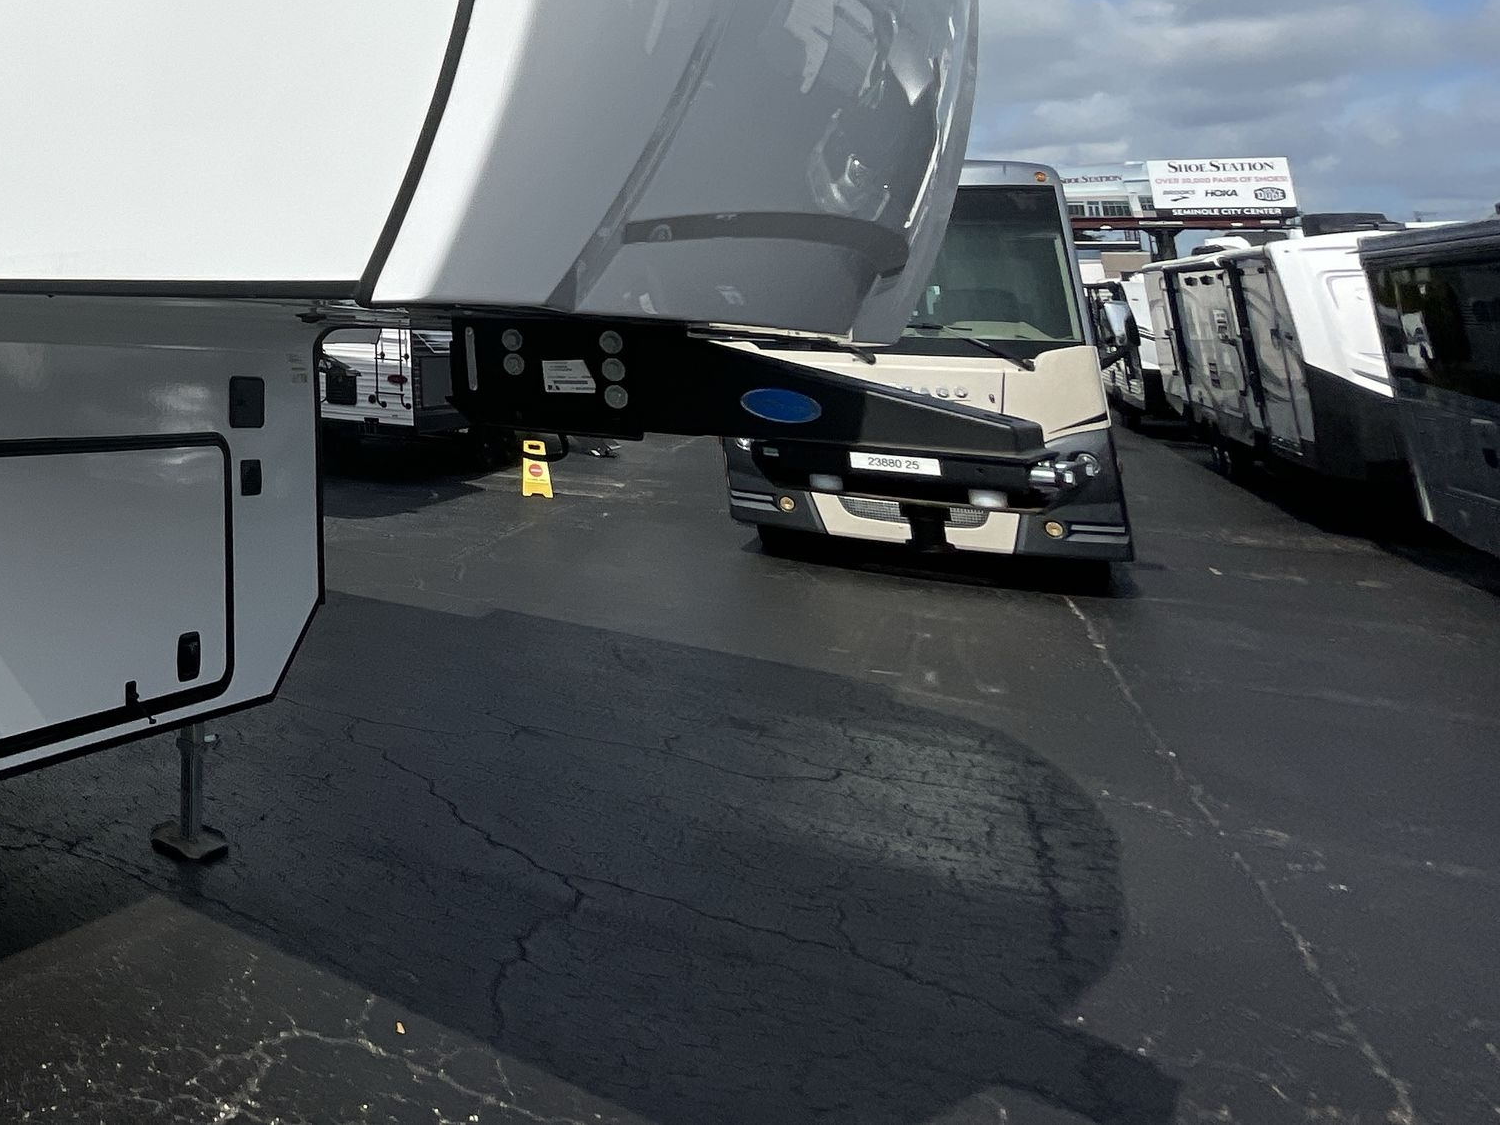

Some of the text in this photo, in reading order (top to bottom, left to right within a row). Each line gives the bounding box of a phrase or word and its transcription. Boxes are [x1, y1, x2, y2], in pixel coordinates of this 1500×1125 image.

[1168, 160, 1275, 173] SHOE STATION
[1081, 175, 1122, 183] STATION
[1212, 176, 1239, 184] PAIRS
[1205, 189, 1239, 197] HOKA
[1171, 207, 1282, 216] SEMINOLE CITY CENTER
[867, 456, 920, 470] 23880 25
